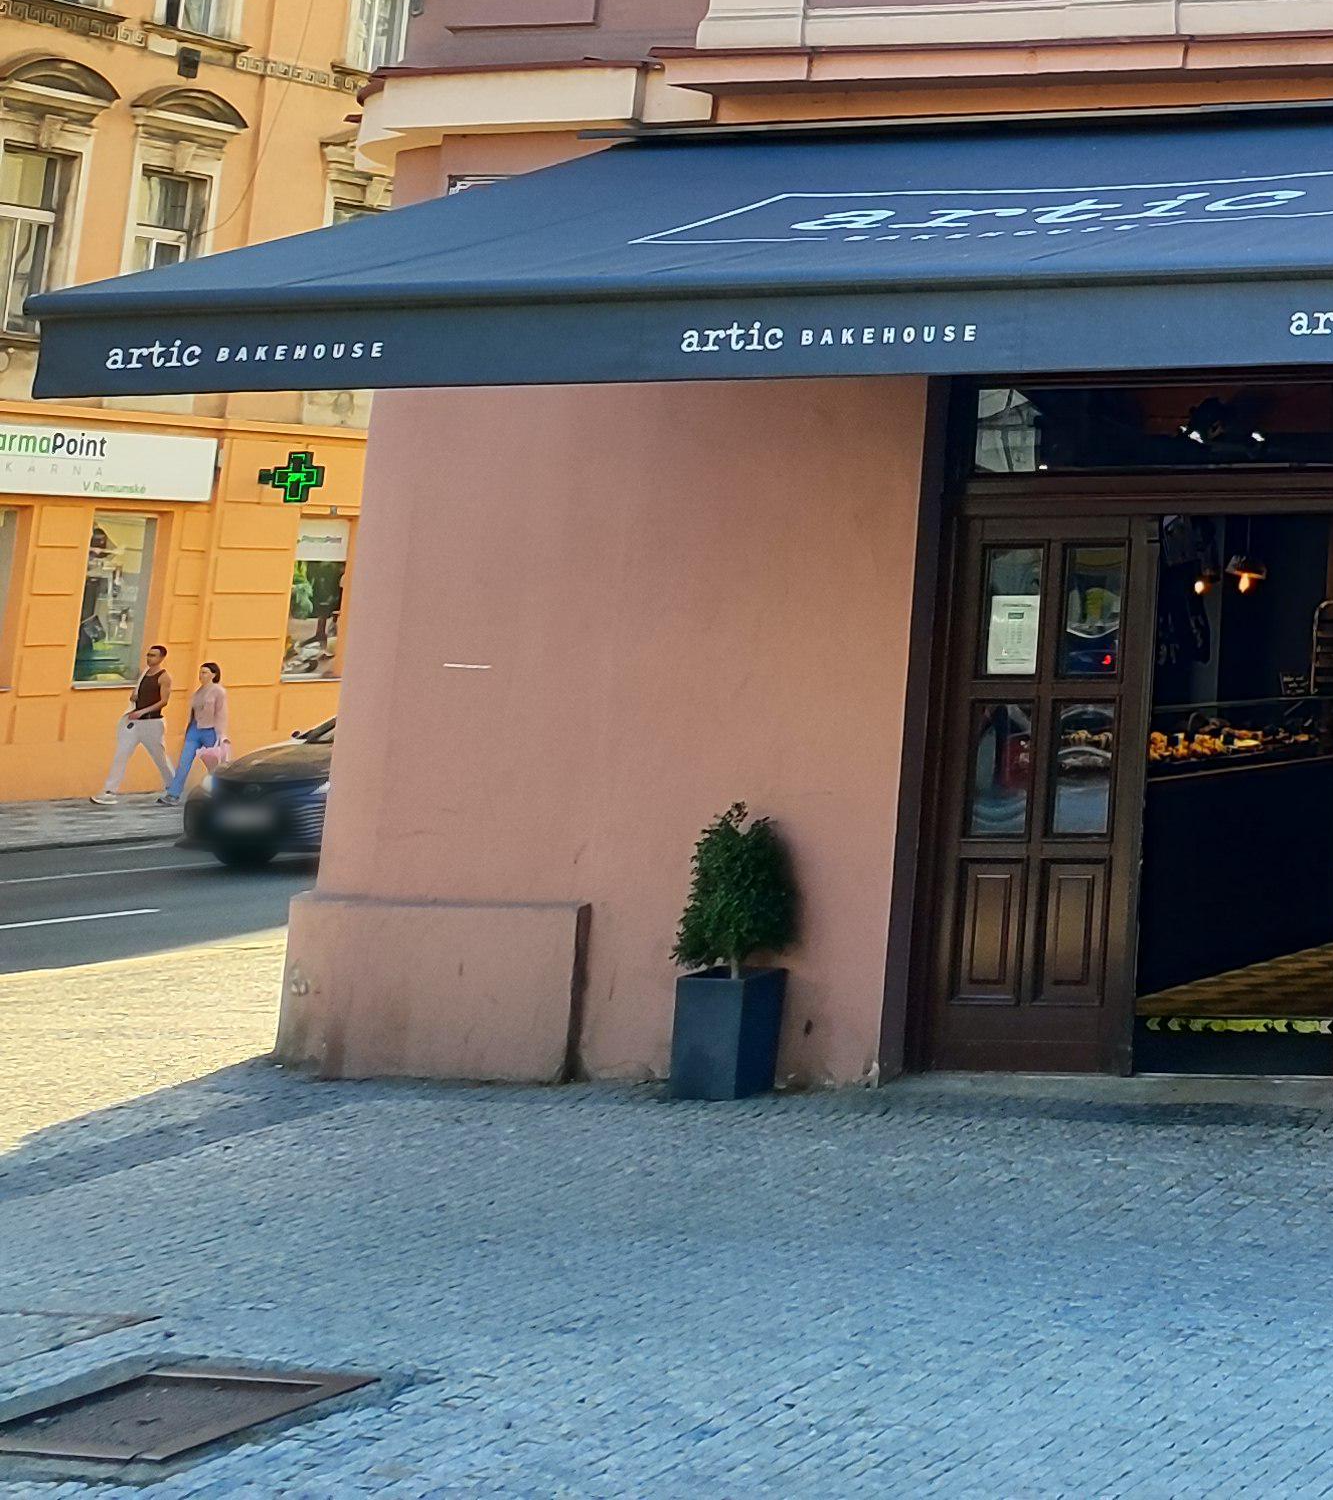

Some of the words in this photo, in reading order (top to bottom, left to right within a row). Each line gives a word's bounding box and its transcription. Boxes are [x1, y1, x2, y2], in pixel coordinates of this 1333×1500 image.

[790, 190, 1307, 230] artic
[680, 321, 784, 353] artic
[801, 325, 977, 346] BAKEHOUSE
[105, 339, 202, 370] artic
[216, 342, 384, 362] BAKEHOUSE
